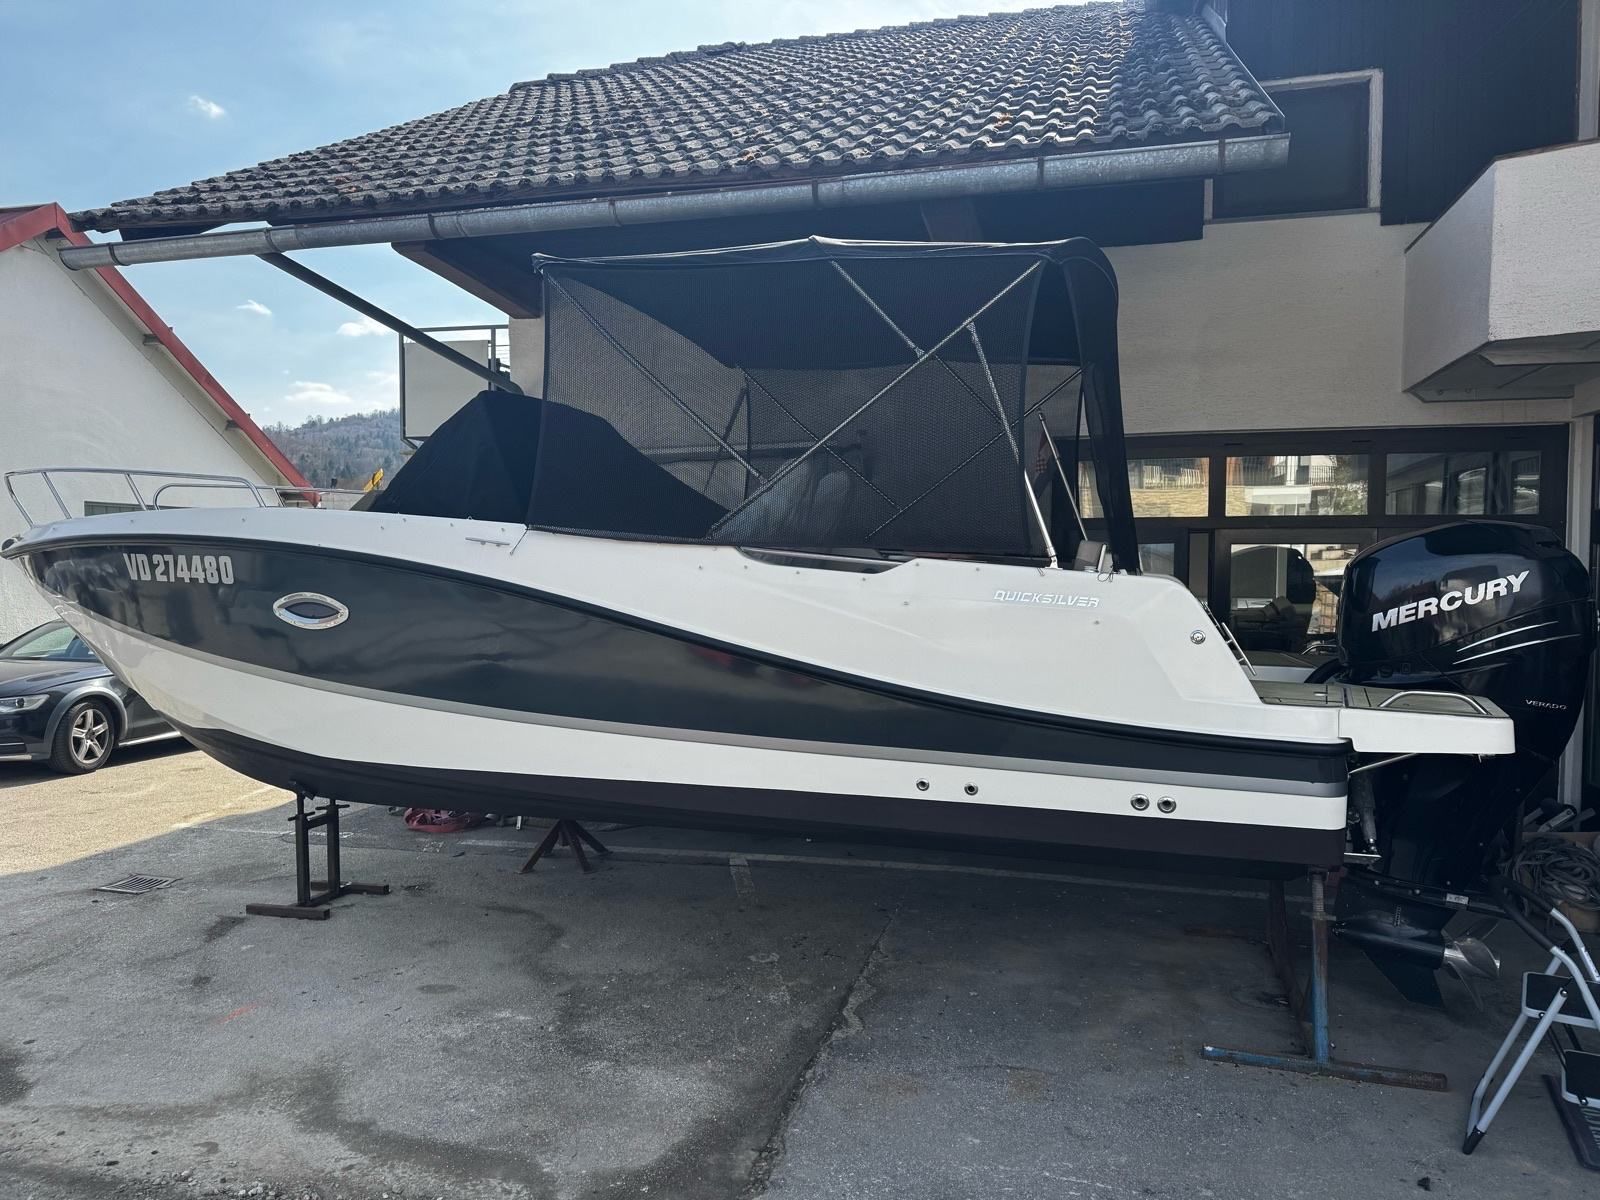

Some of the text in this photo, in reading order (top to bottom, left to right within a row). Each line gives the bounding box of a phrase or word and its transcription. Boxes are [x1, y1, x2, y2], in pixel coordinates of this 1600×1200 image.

[123, 553, 235, 585] VD 274480
[993, 589, 1100, 608] QUICKSILVER
[1371, 569, 1530, 633] MERCURY
[1525, 699, 1568, 711] VERADO
